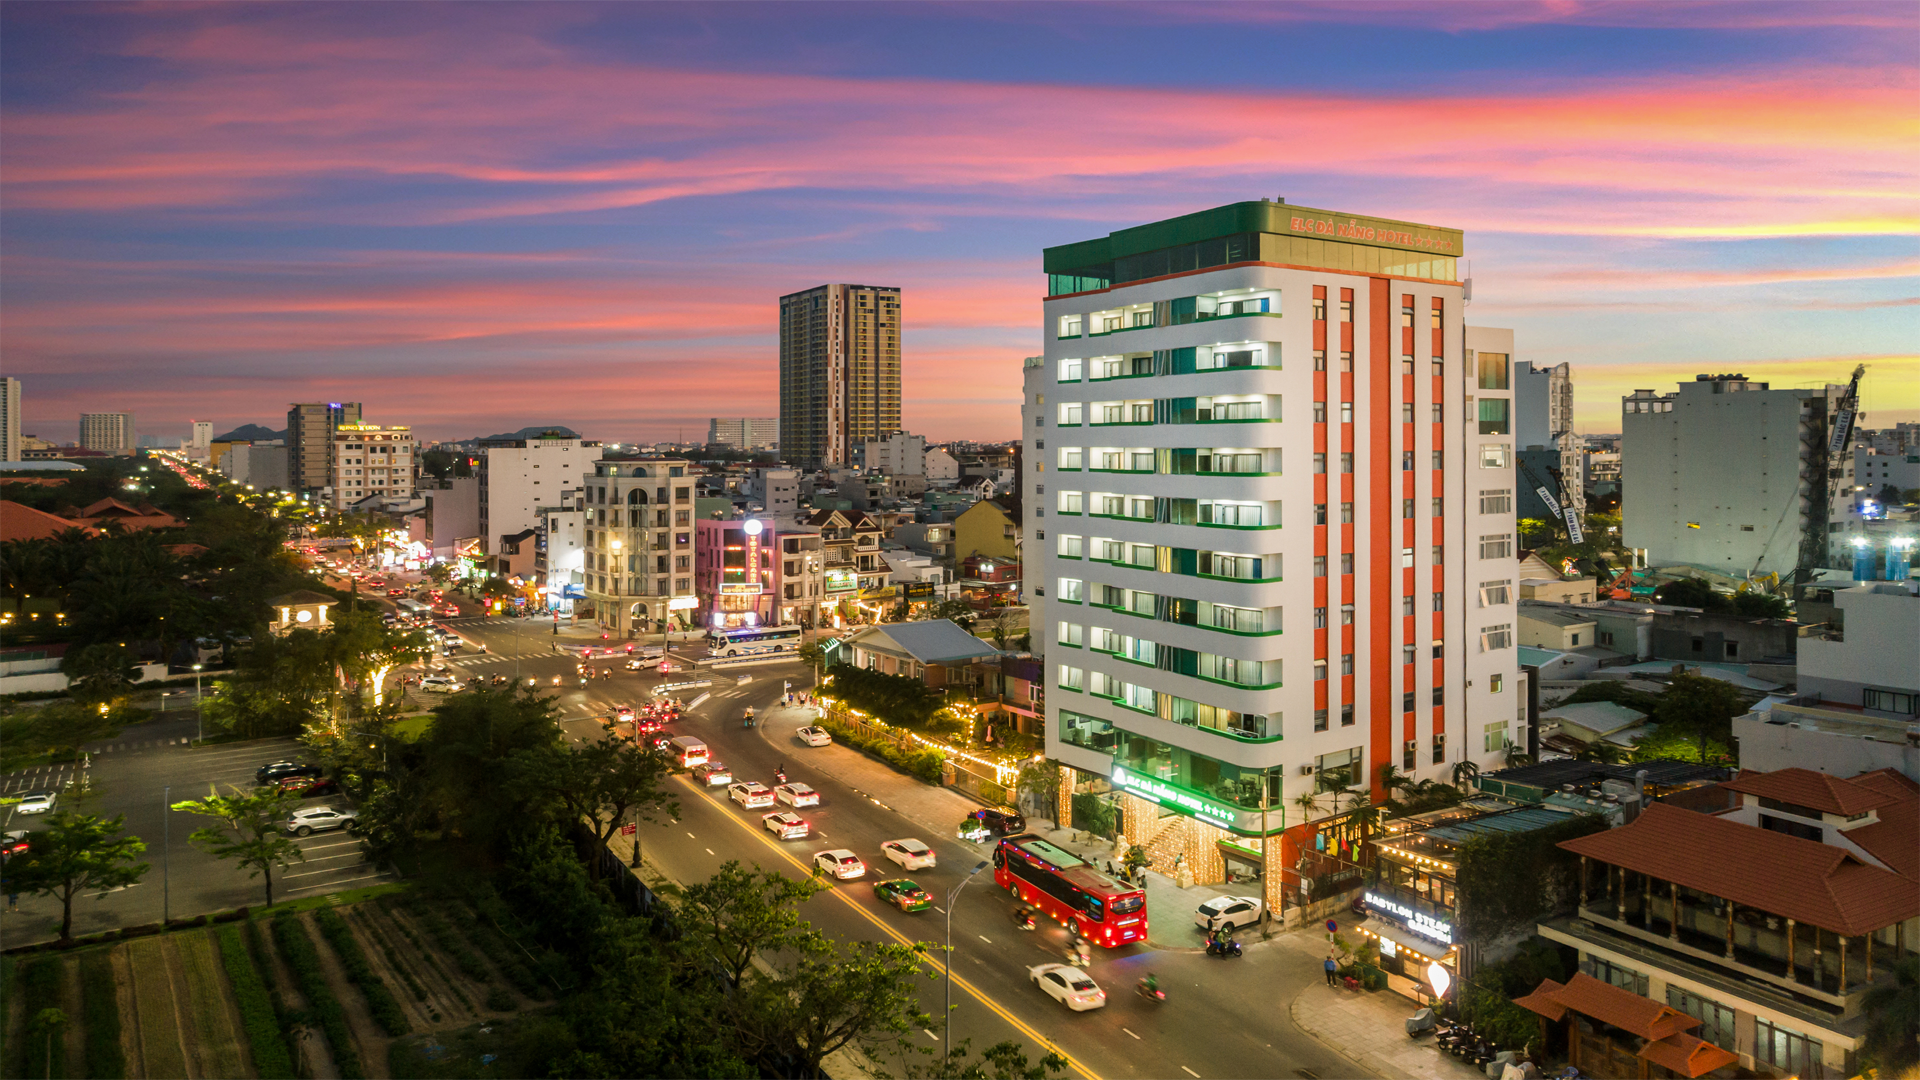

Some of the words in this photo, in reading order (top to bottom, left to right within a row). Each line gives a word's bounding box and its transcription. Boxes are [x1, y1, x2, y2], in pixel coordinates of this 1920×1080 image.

[1290, 216, 1314, 233] ELC
[1315, 218, 1335, 236] ĐÀ
[1376, 229, 1414, 246] HOTEL
[1365, 892, 1413, 919] BABYLON
[1414, 912, 1451, 933] STEAK
